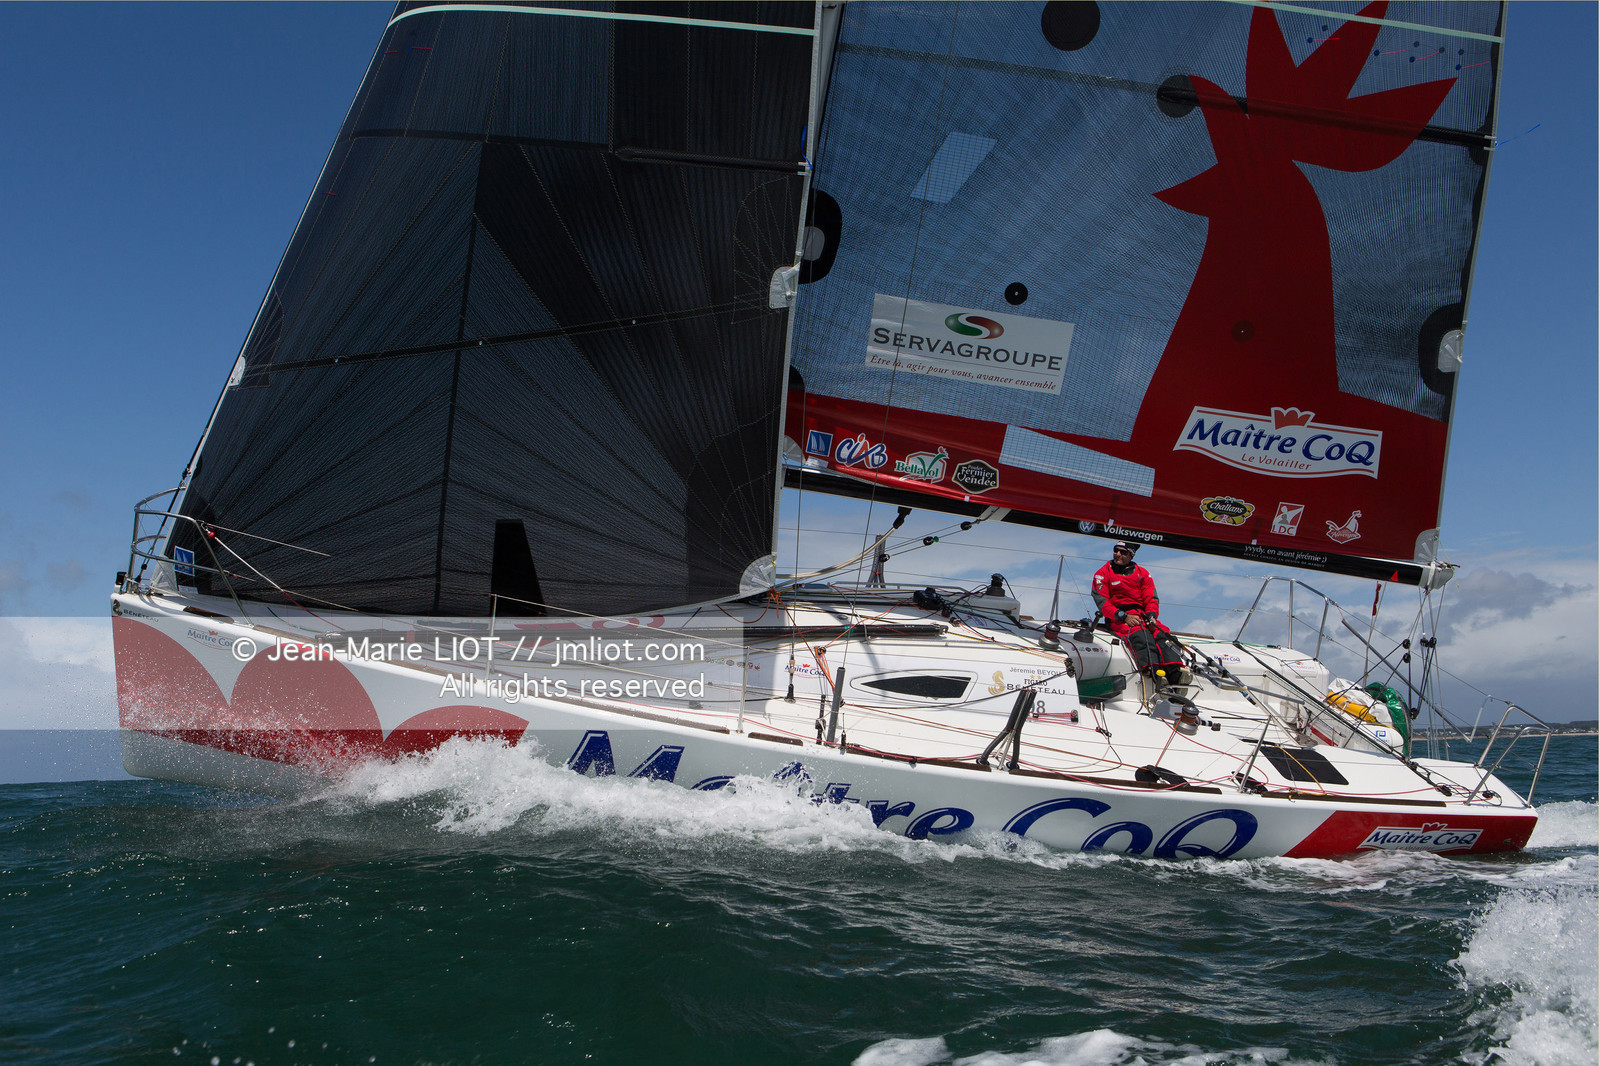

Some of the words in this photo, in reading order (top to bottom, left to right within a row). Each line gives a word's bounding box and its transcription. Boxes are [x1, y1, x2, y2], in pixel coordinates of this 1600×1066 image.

[873, 327, 1063, 371] SERVAGROUPE
[870, 354, 890, 366] Être
[906, 362, 926, 372] agir
[926, 365, 949, 374] pour
[951, 369, 974, 379] vous,
[976, 373, 1013, 384] avancer
[1015, 379, 1057, 391] ensemble
[1187, 418, 1297, 454] Maître
[1302, 433, 1376, 466] CoQ
[1241, 453, 1256, 462] Le
[1259, 455, 1312, 471] Volailler
[957, 472, 996, 487] Vendée
[961, 467, 995, 478] Fermier
[1209, 503, 1244, 513] Challans
[1103, 524, 1163, 541] Volkswagen
[1271, 525, 1296, 535] LDC
[187, 630, 217, 643] Maître
[1367, 831, 1434, 845] Maître
[1433, 832, 1478, 846] CoQ
